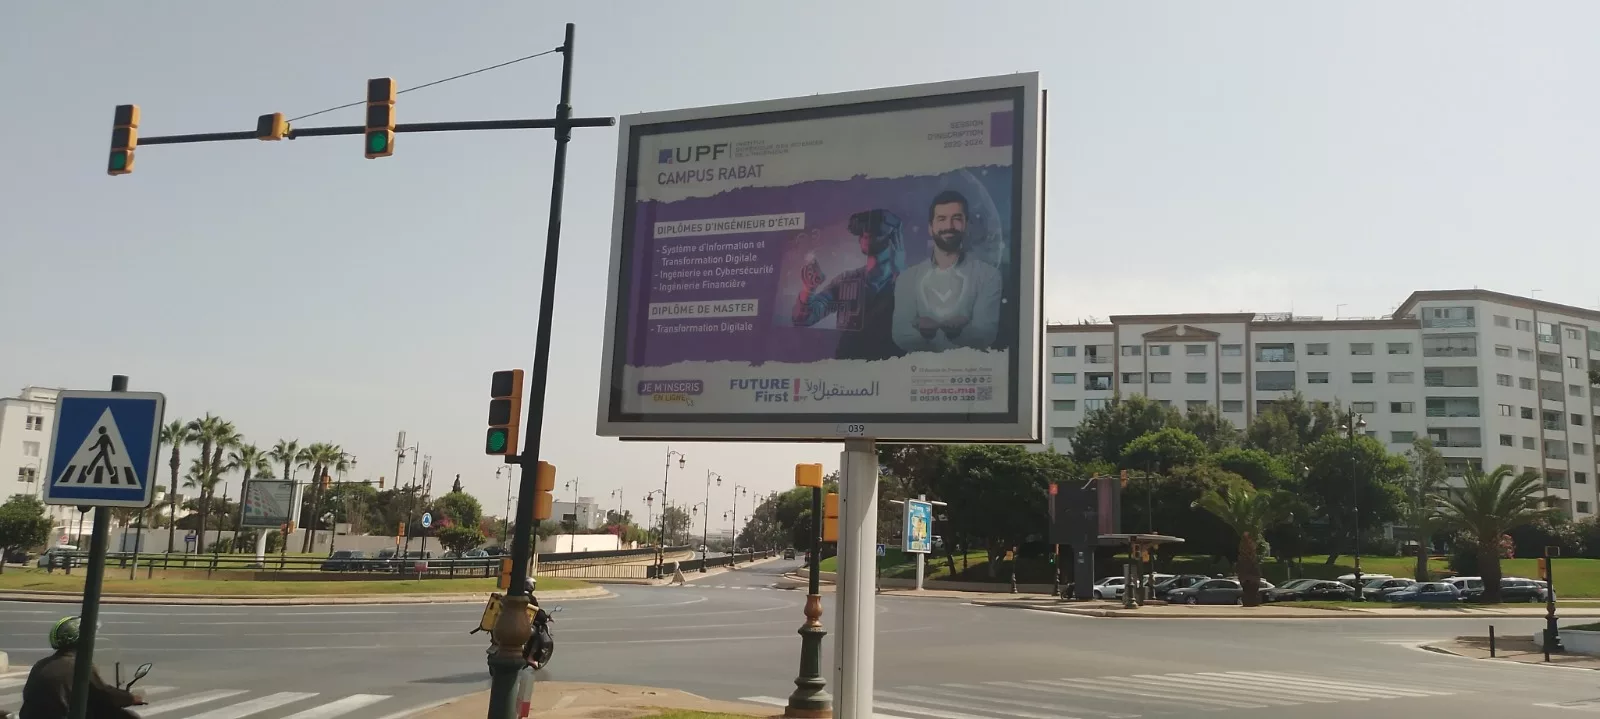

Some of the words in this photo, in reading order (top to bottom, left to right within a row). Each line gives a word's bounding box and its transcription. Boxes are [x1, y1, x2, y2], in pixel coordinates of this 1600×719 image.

[950, 120, 984, 128] SESSION
[676, 143, 728, 163] UPF
[658, 169, 714, 185] CAMPUS
[718, 164, 764, 180] RABAT
[657, 222, 702, 235] DIPLÔMES
[705, 217, 765, 232] D'INGÉNIEUR
[768, 216, 800, 228] D'ÉTAT
[662, 245, 696, 256] Système
[756, 240, 765, 248] et
[662, 256, 723, 267] Transformation
[725, 252, 757, 264] Digitale
[660, 269, 701, 280] Ingénierie
[715, 265, 774, 277] Cybersécurité
[659, 281, 700, 293] Ingénierie
[702, 280, 746, 290] Financière
[652, 304, 693, 315] DIPLÔME
[697, 304, 711, 314] DE
[713, 303, 754, 313] MASTER
[656, 323, 719, 333] Transformation
[720, 322, 753, 333] Digitale
[641, 383, 652, 392] JE
[654, 382, 700, 392] M'INSCRIS
[729, 378, 790, 390] FUTURE
[755, 391, 788, 402] First
[848, 424, 865, 433] 039
